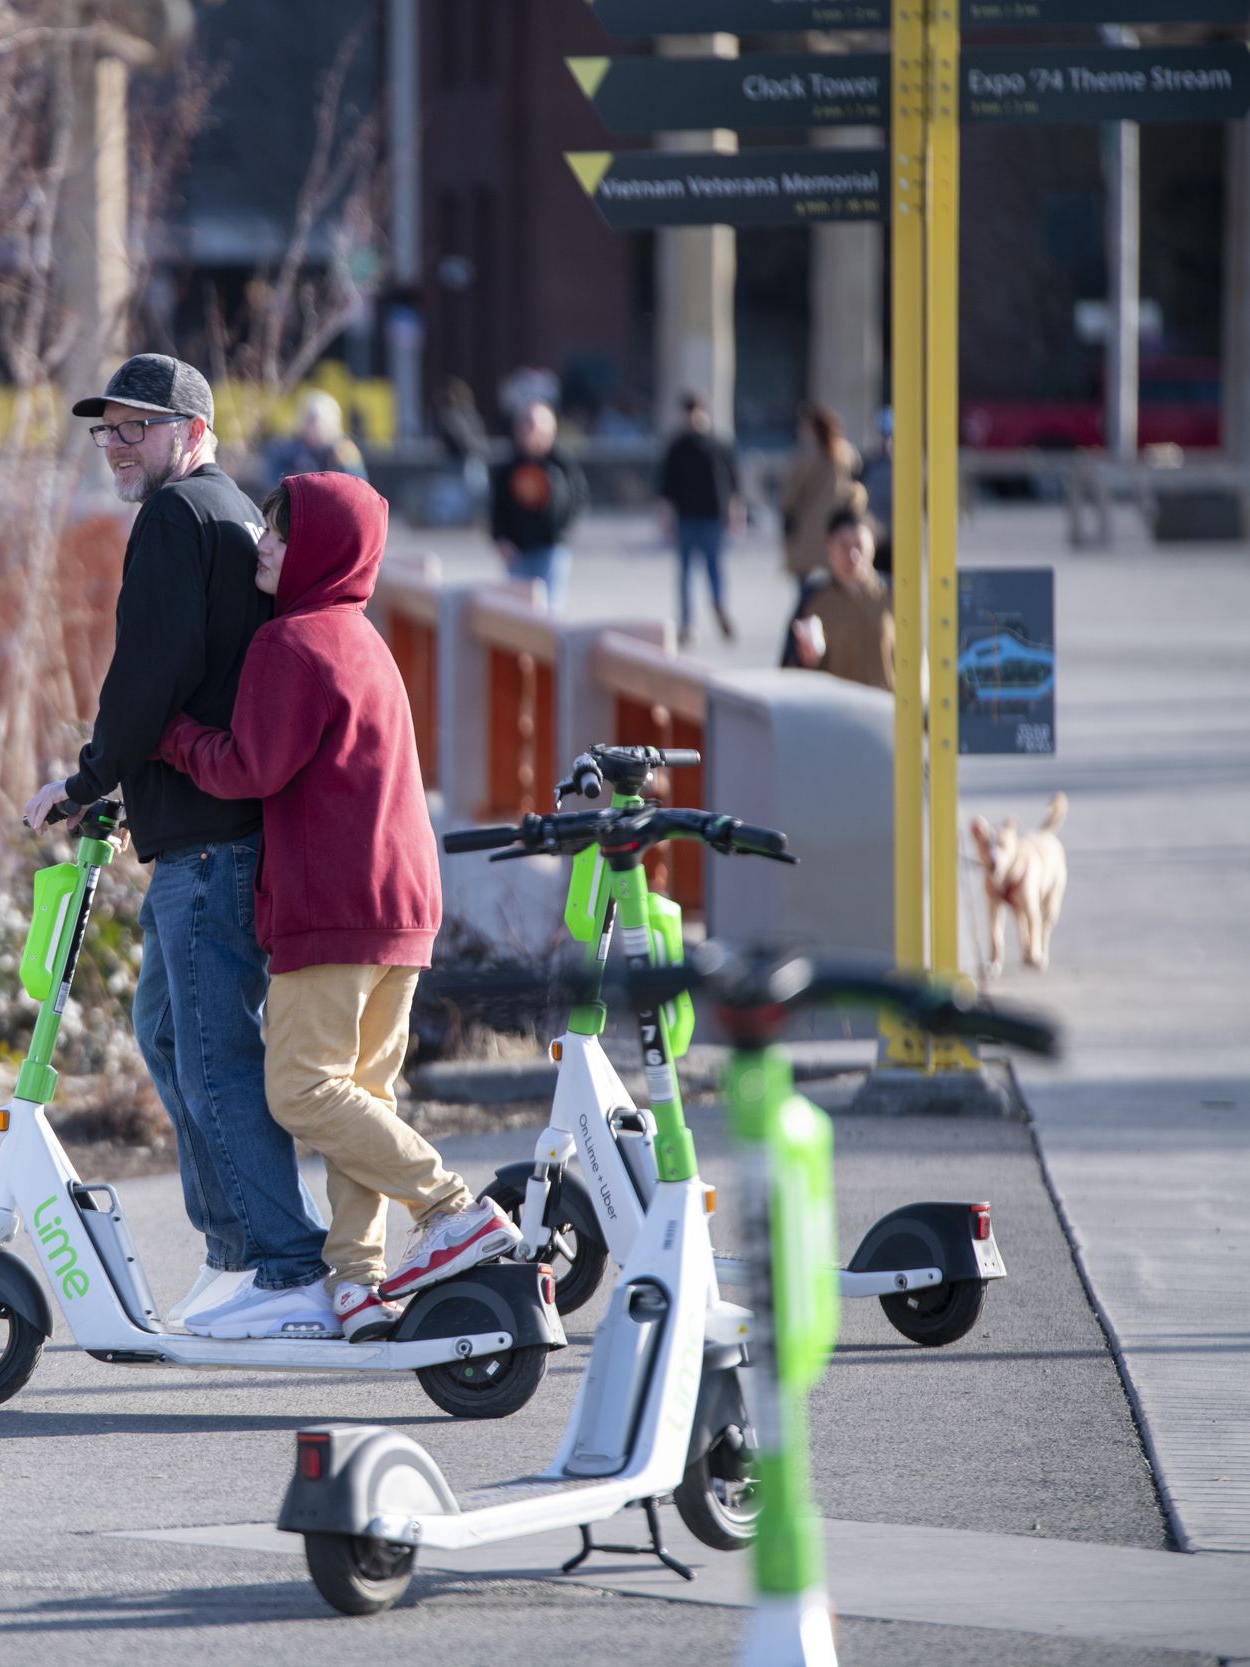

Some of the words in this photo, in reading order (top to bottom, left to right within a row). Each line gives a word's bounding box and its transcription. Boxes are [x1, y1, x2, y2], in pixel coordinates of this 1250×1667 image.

[742, 73, 806, 100] Clock
[809, 72, 879, 98] Tower
[968, 69, 1026, 97] Expo
[1068, 66, 1147, 92] Theme
[1150, 65, 1232, 92] Stream
[600, 177, 684, 198] Vietnam
[687, 174, 778, 197] Veterans
[781, 170, 879, 194] Memorial
[579, 1113, 588, 1135] On
[584, 1136, 599, 1172] Lime
[600, 1182, 617, 1220] Uber
[33, 1194, 90, 1300] Lime
